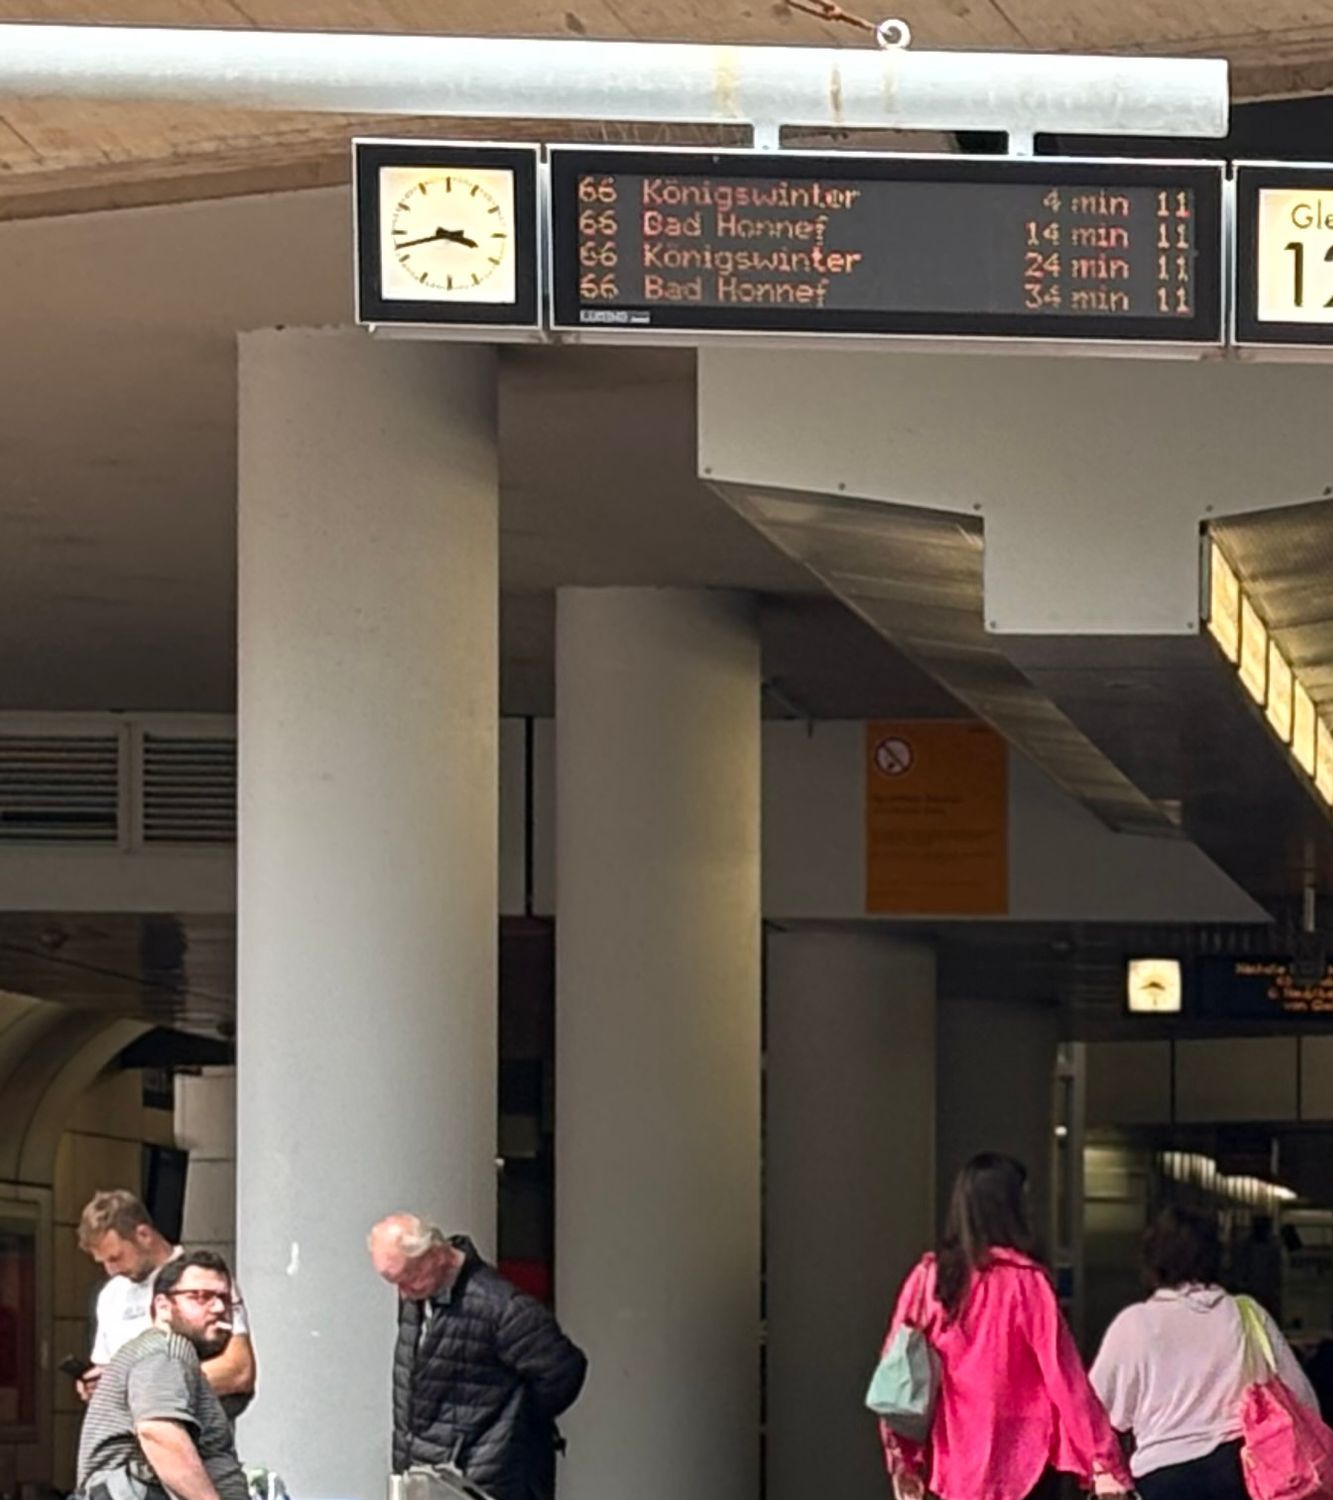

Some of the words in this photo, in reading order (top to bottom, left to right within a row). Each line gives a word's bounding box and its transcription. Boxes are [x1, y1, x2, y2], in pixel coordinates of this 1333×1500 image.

[578, 178, 618, 203] 66
[642, 178, 861, 212] Königswinter
[1043, 190, 1061, 214] 4
[1071, 194, 1130, 217] min
[1157, 191, 1190, 218] 11
[578, 209, 619, 236] 66
[642, 209, 702, 237] Bad
[716, 212, 829, 247] Honnef
[1024, 221, 1061, 246] 14
[1071, 224, 1130, 249] min
[1157, 222, 1190, 249] 11
[579, 241, 619, 268] 66
[642, 242, 862, 275] Königswinter
[1024, 252, 1061, 278] 24
[1071, 255, 1130, 280] min
[1157, 253, 1190, 281] 11
[579, 274, 619, 301] 66
[642, 275, 702, 300] Bad
[716, 277, 830, 310] Honnef
[1024, 283, 1061, 310] 34
[1071, 286, 1130, 312] min
[1157, 285, 1190, 313] 11
